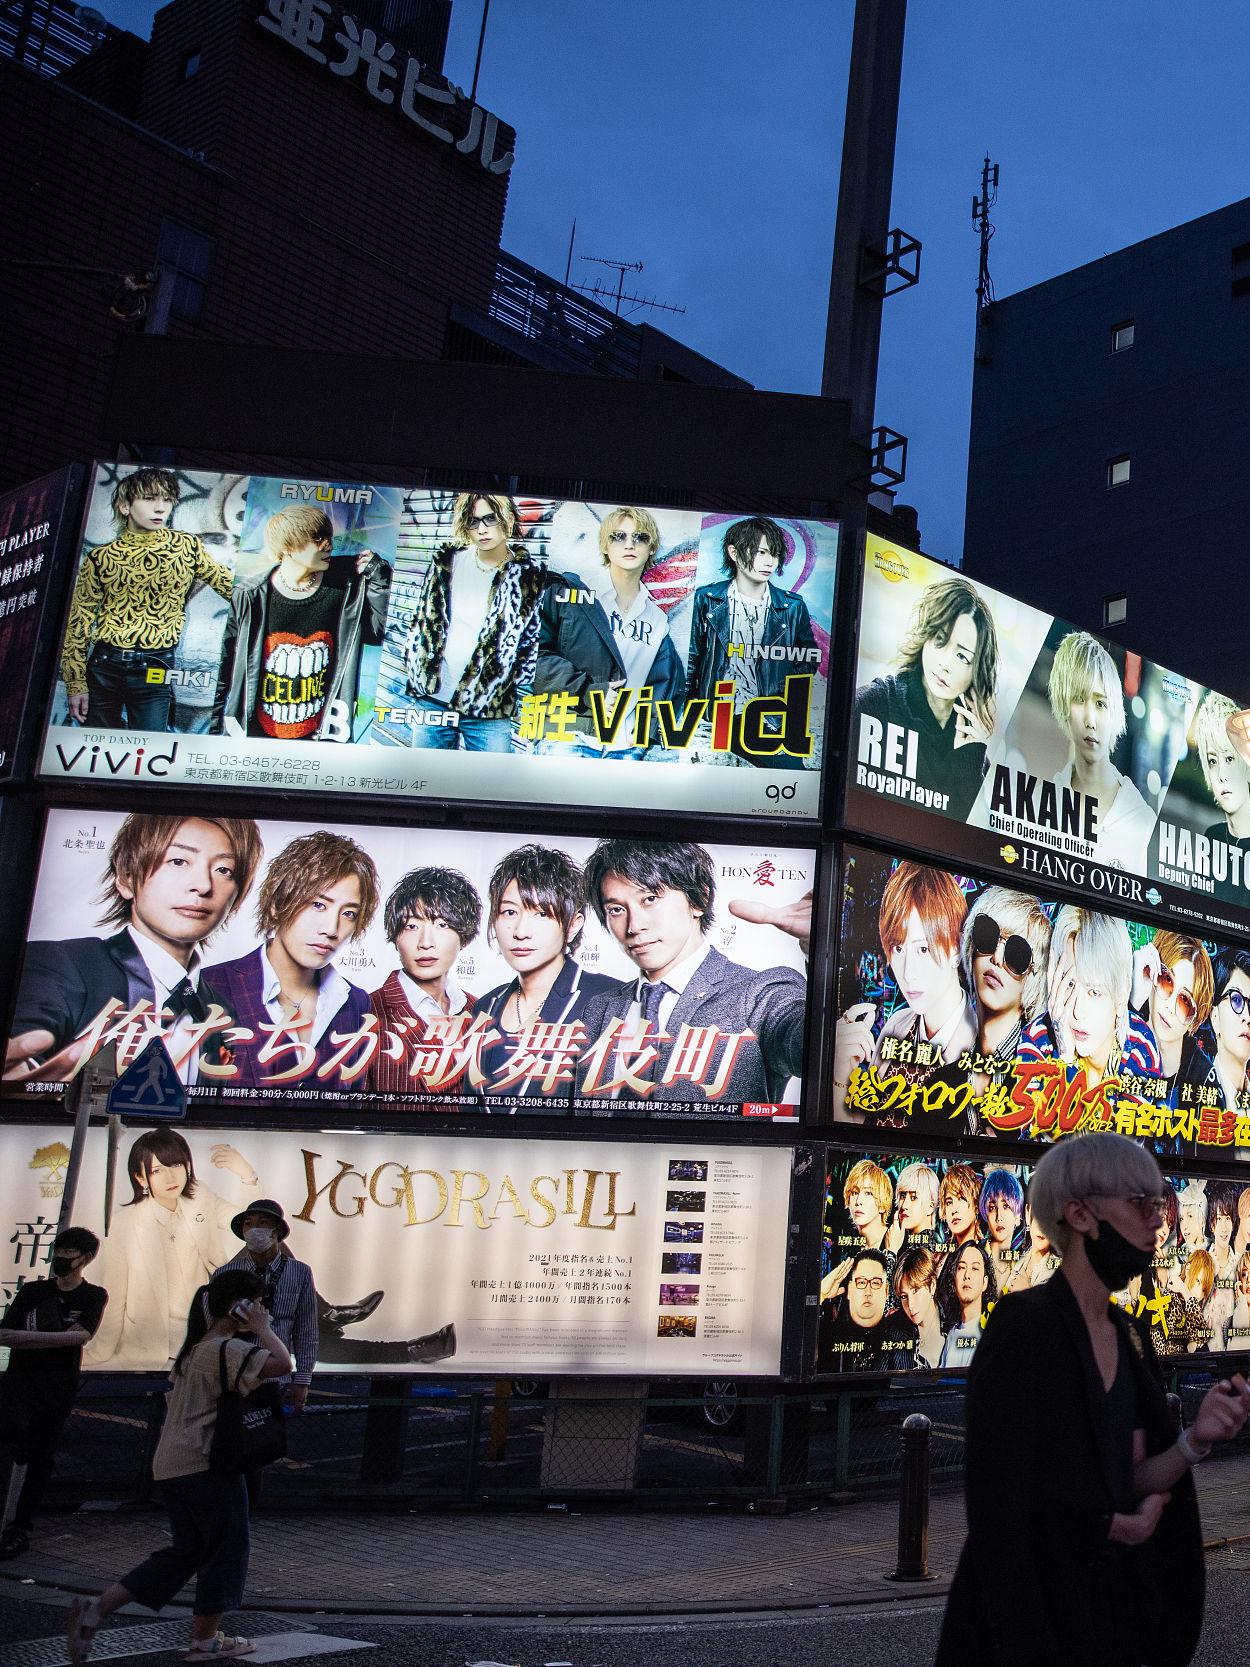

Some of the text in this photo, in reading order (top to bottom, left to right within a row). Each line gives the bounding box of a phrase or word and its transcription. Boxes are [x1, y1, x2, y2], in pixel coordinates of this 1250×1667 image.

[280, 483, 373, 505] RYUMA
[555, 588, 597, 605] JIN
[727, 642, 823, 663] HINOWA
[145, 667, 213, 689] BAKI
[262, 668, 327, 704] CELINE
[373, 705, 461, 728] TENGA
[518, 673, 814, 758] 新生 Vivid
[83, 733, 149, 746] TOP DANDY
[857, 712, 919, 780] REI
[55, 741, 178, 776] Vivid
[219, 754, 321, 771] 03-6457-6228
[184, 766, 309, 785] 東京都新宿区歌舞伎町
[312, 773, 356, 787] 1-2-13
[410, 779, 428, 791] 4F
[856, 764, 950, 811] RoyalPlayer
[991, 764, 1099, 845] AKANE
[77, 826, 97, 838] No.1
[989, 814, 1095, 858] Chief Operating Officer
[721, 860, 808, 887] HON 愛 TEN
[1020, 845, 1145, 903] HANG OVER
[1158, 863, 1215, 894] Deputy Chief
[720, 925, 737, 935] No.2
[350, 947, 366, 957] No.3
[458, 956, 475, 966] No.5
[455, 964, 476, 975] 和也
[72, 998, 758, 1100] 俺たちが歌舞伎町
[880, 1036, 946, 1068] 椎名 麗人
[957, 1051, 1012, 1075] みとなつ
[26, 1082, 64, 1093] 営業時間
[1119, 1075, 1143, 1095] 渋谷
[1181, 1083, 1193, 1102] 社
[485, 1096, 503, 1106] TEL
[504, 1096, 569, 1108] 03-3208-6435
[574, 1098, 690, 1112] 東京都新宿区歌舞伎町2-25-2
[748, 1105, 771, 1116] 20m
[290, 1149, 638, 1233] YGGDRASILL
